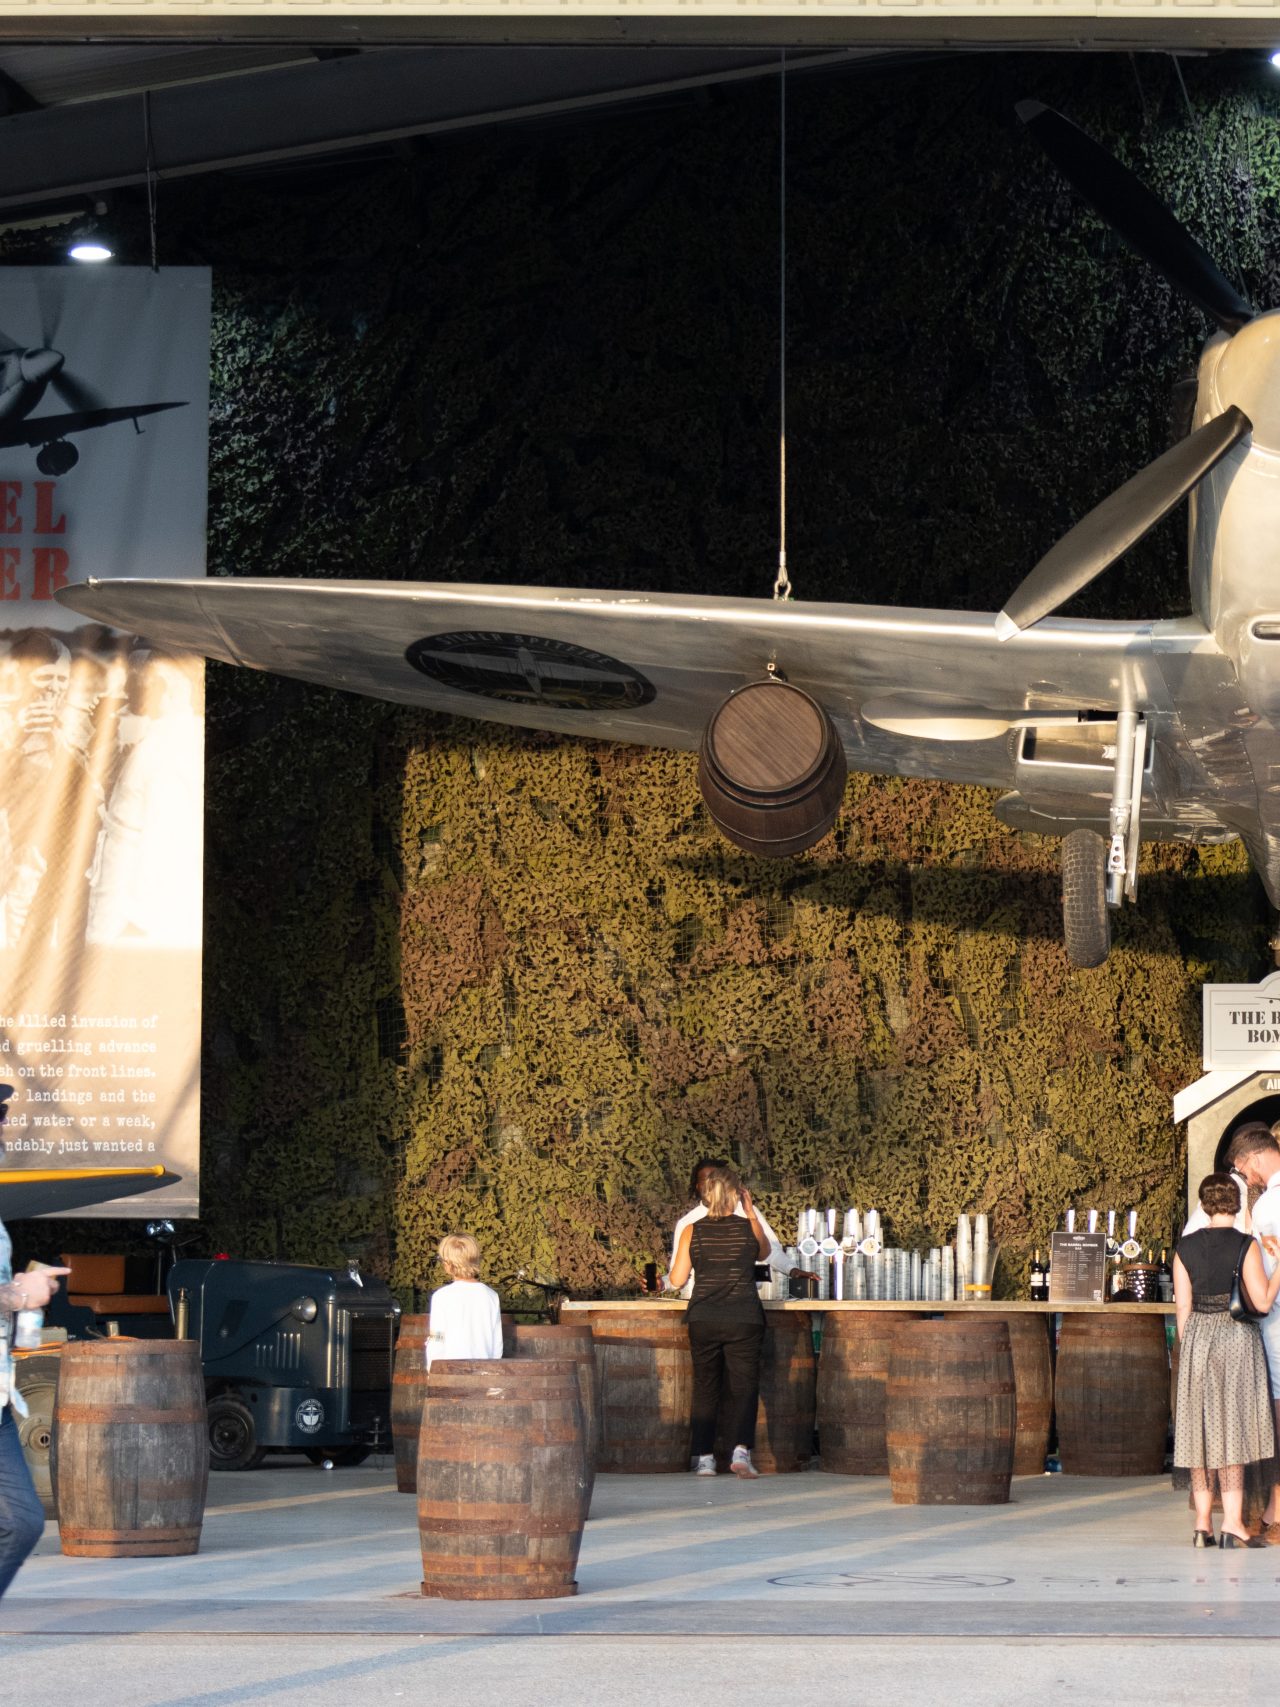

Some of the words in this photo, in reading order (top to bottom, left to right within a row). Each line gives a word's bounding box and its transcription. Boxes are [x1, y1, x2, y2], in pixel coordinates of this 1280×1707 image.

[435, 632, 504, 646] SILVER
[514, 635, 615, 665] SPITFIRE
[18, 1014, 67, 1028] Allied
[71, 1015, 138, 1028] invasion
[142, 1014, 159, 1028] of
[1229, 1011, 1266, 1025] THE
[17, 1039, 92, 1056] gruelling
[99, 1040, 157, 1053] advance
[18, 1066, 35, 1078] on
[39, 1064, 64, 1078] the
[68, 1064, 107, 1078] front
[111, 1064, 156, 1078] lines.
[26, 1089, 93, 1106] landings
[99, 1089, 125, 1103] and
[132, 1090, 156, 1103] the
[33, 1114, 75, 1127] water
[80, 1116, 97, 1127] or
[102, 1116, 111, 1127] a
[116, 1114, 156, 1130] weak,
[58, 1138, 89, 1154] just
[93, 1139, 144, 1152] wanted
[147, 1141, 156, 1152] a
